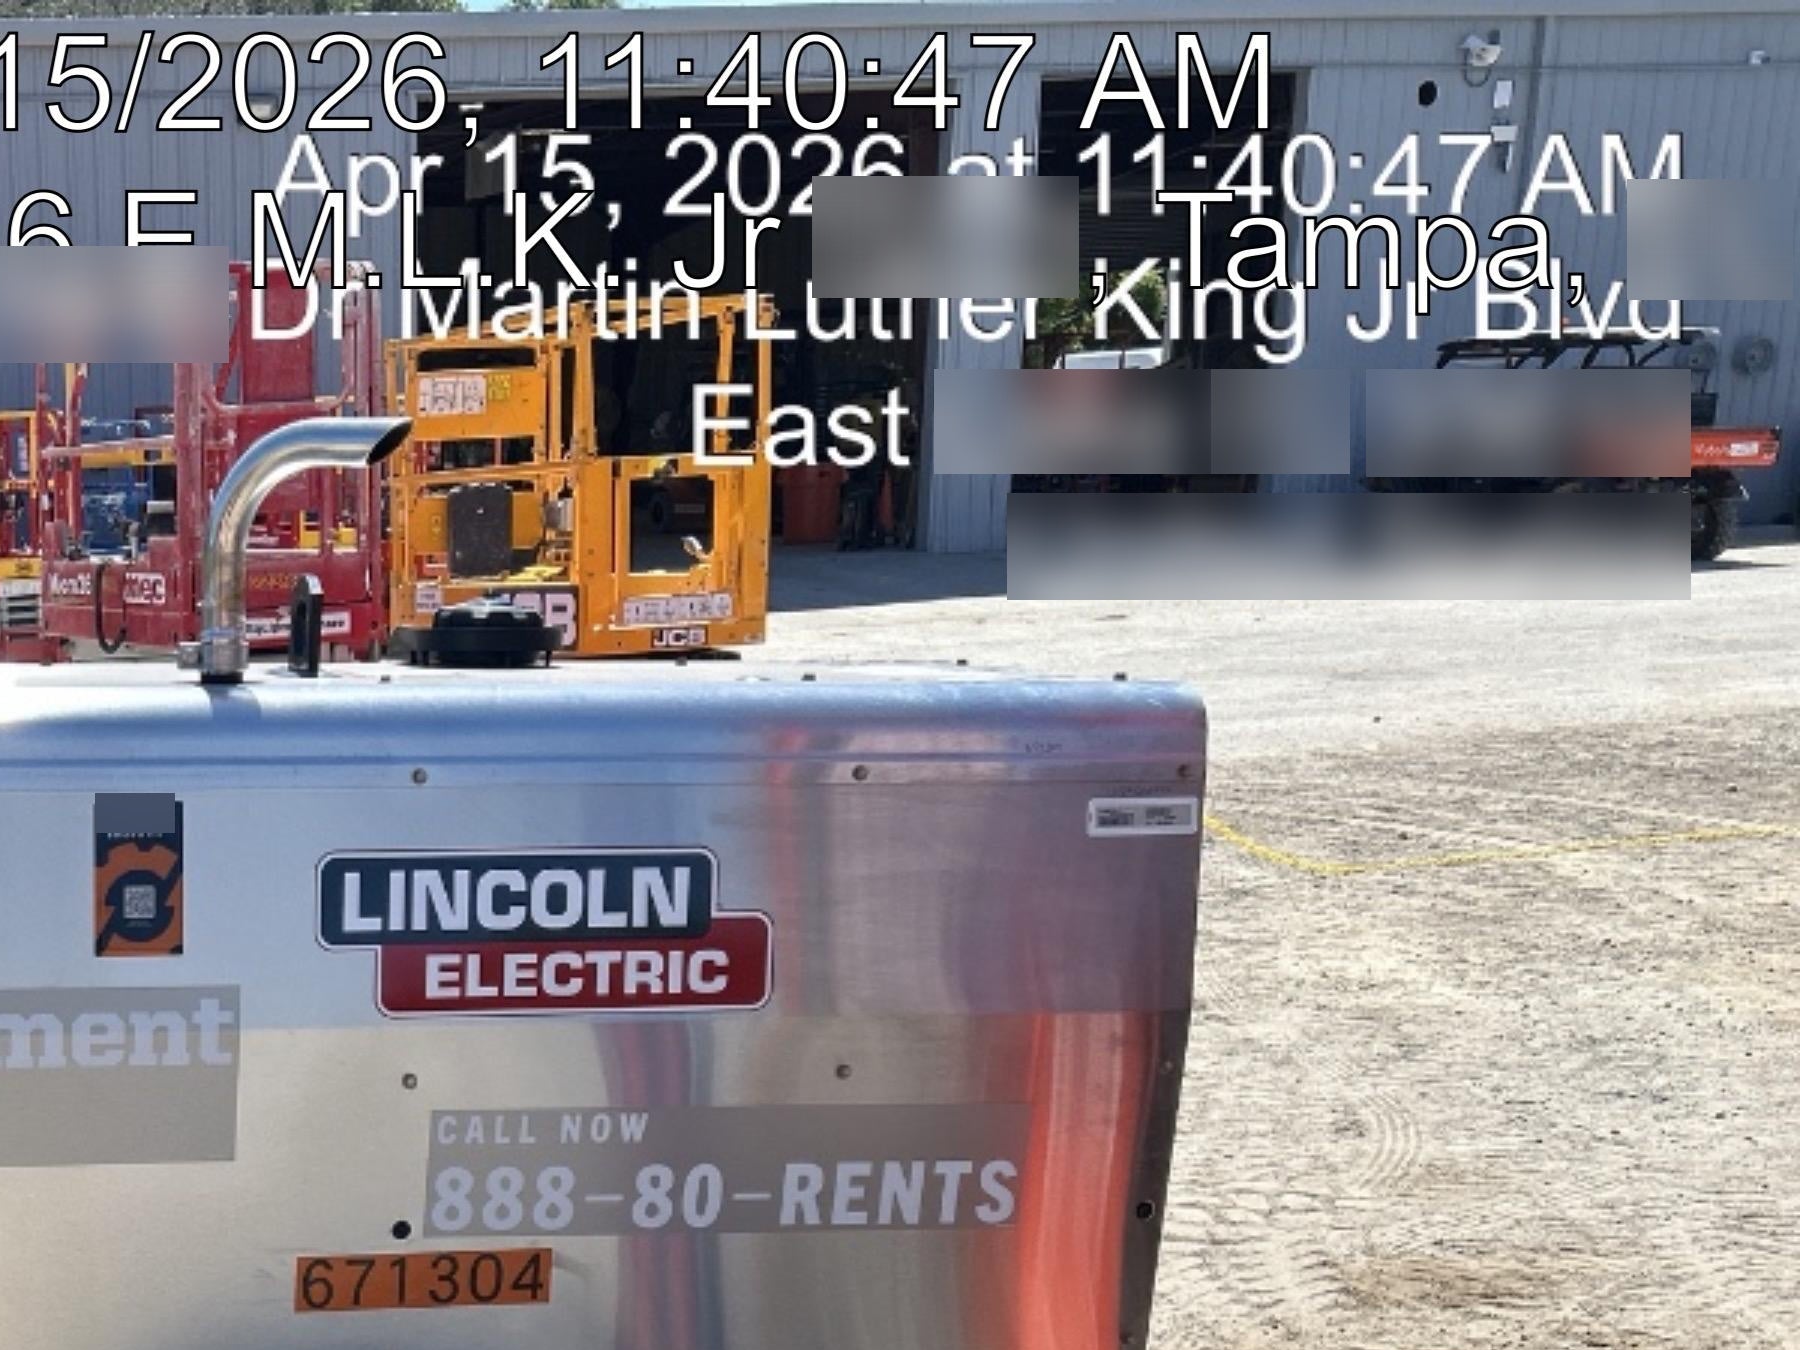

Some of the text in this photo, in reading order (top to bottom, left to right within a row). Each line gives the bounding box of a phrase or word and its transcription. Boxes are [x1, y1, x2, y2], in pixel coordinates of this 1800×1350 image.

[653, 627, 706, 648] JCB
[341, 867, 692, 932] LINCOLN
[425, 949, 729, 999] ELECTRIC
[436, 1111, 649, 1145] CALL NOW
[431, 1159, 1018, 1232] 888-80-RENTS
[301, 1252, 544, 1310] 671304
